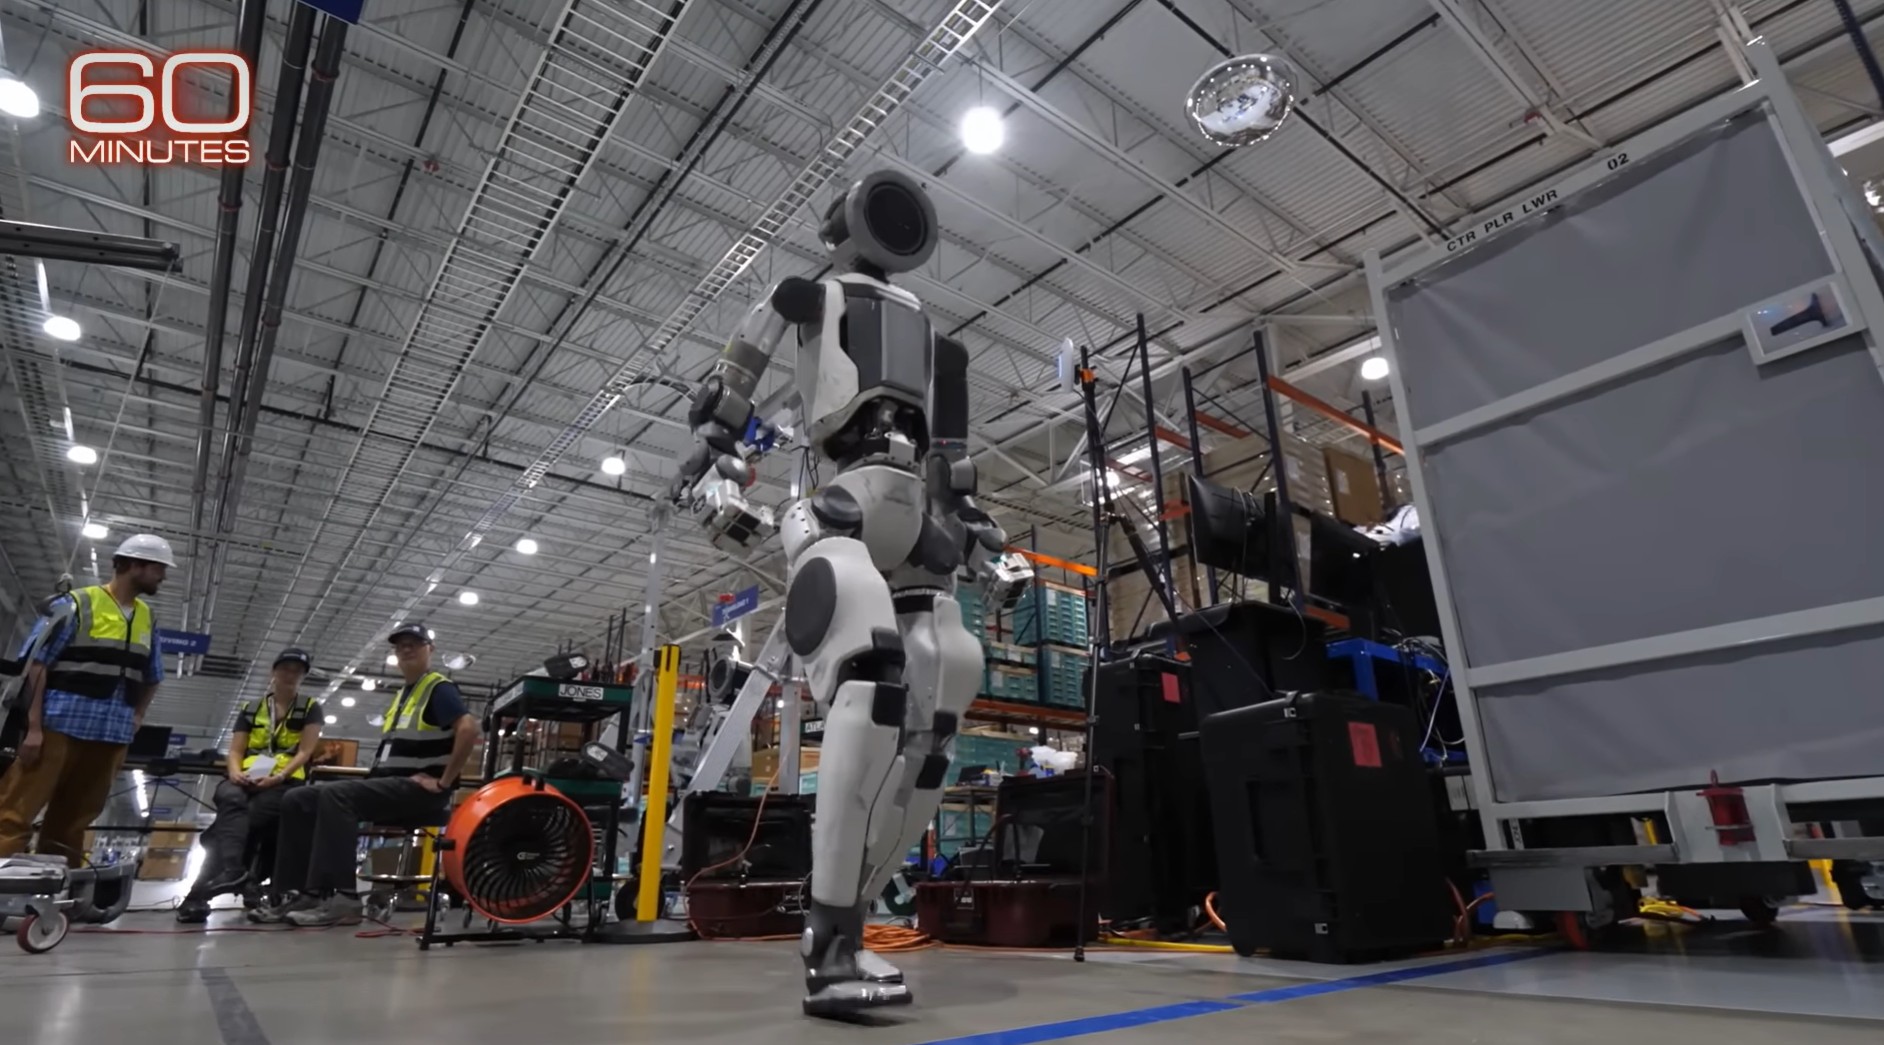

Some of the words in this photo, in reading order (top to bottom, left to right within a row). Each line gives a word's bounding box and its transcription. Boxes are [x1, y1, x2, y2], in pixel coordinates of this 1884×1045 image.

[1446, 231, 1477, 252] CTR
[1484, 211, 1514, 233] PLR
[1522, 189, 1558, 214] LWR
[1607, 153, 1630, 171] 02
[560, 685, 602, 698] JONES
